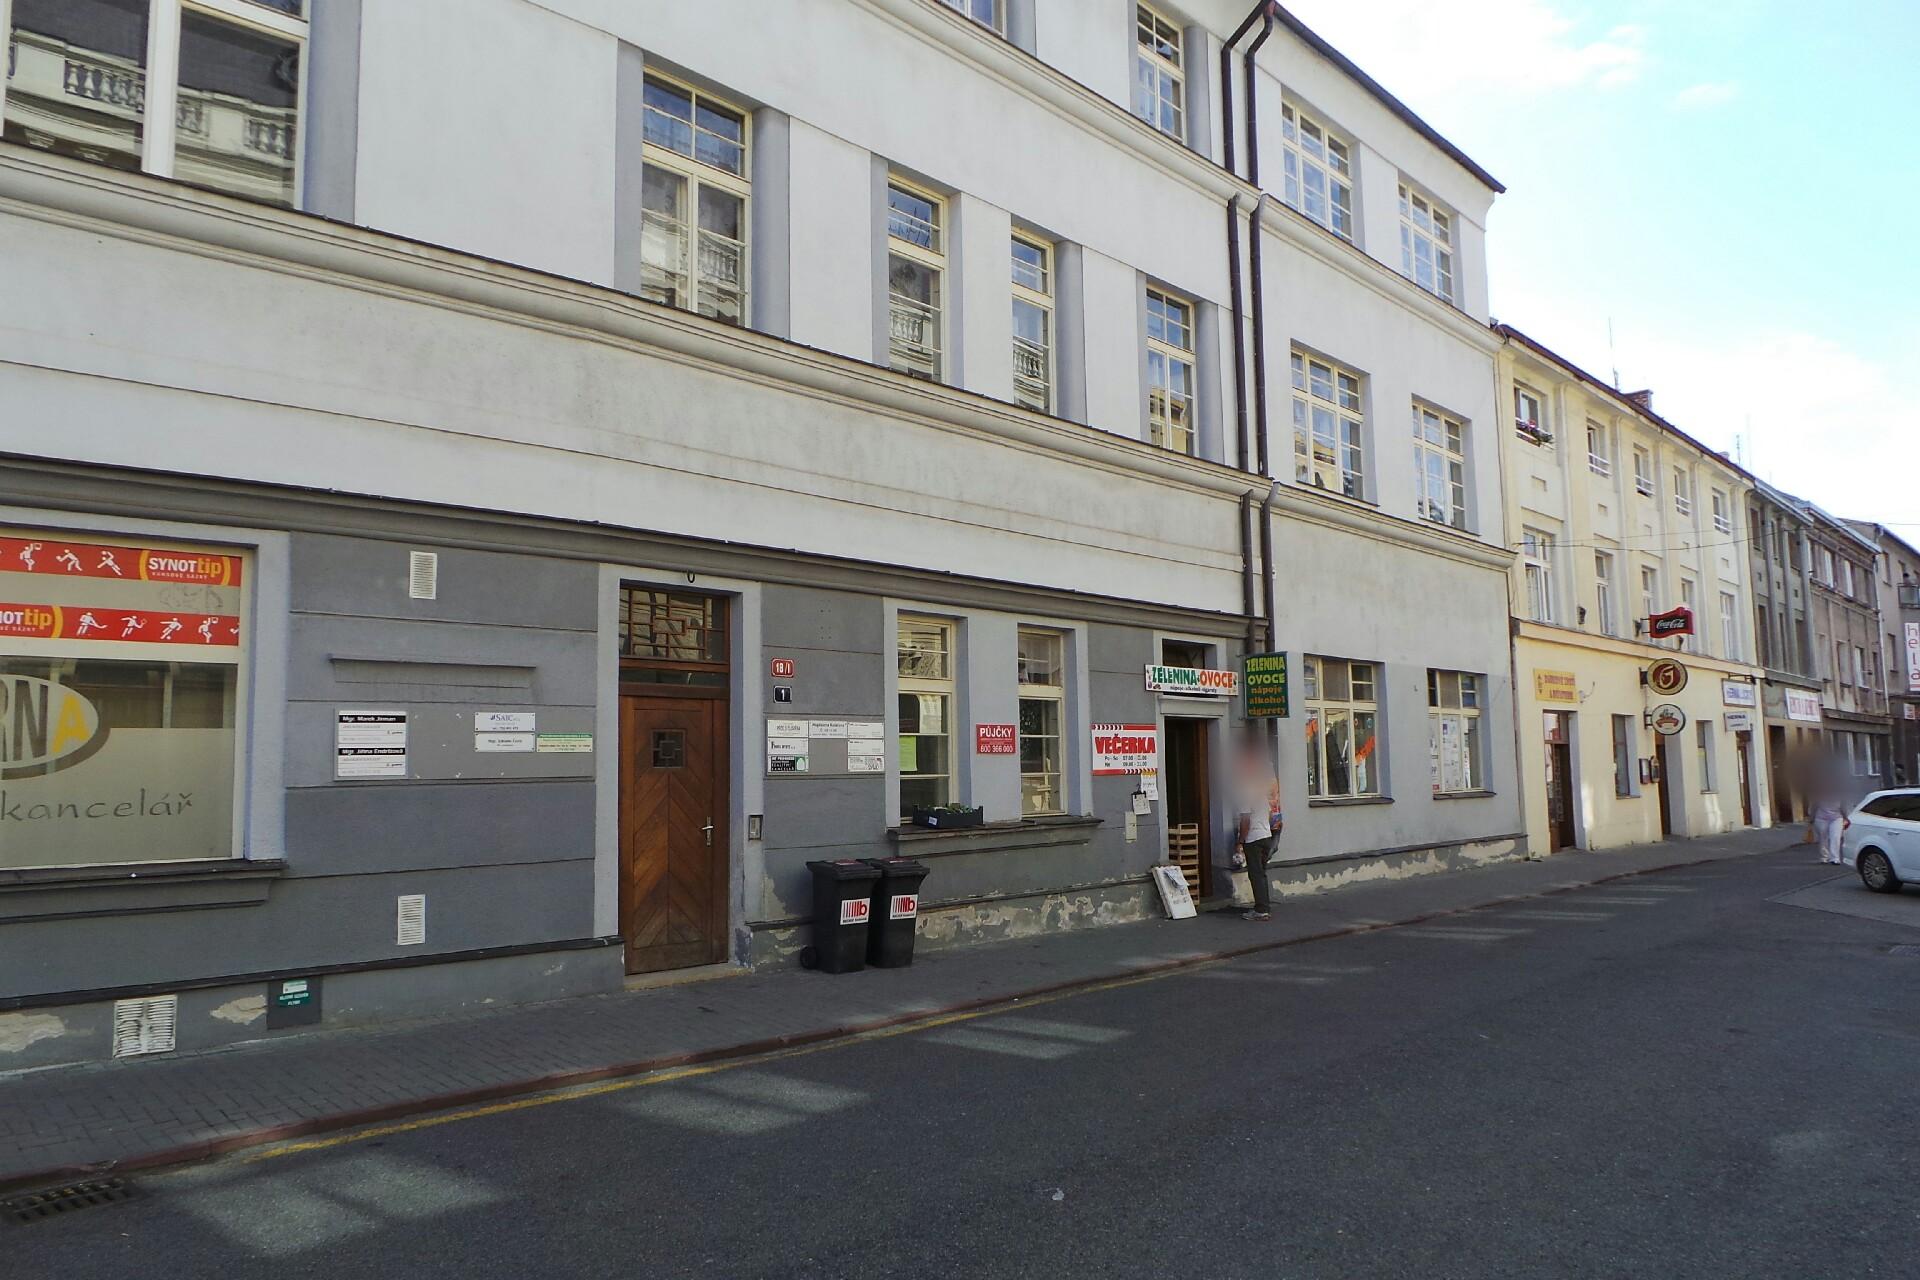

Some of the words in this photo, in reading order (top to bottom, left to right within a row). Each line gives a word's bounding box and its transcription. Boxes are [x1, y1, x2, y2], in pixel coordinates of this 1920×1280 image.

[0, 608, 53, 630] OTtip
[1656, 619, 1686, 631] Coca-Cola
[1247, 656, 1286, 672] ZELENINA
[1152, 666, 1197, 685] ZELENINA
[1200, 671, 1233, 688] OVOCE
[1247, 673, 1285, 685] OVOCE
[780, 689, 785, 700] 1
[1249, 696, 1286, 705] alkohol
[1094, 733, 1156, 754] VEČERKA
[0, 787, 193, 822] kancelář
